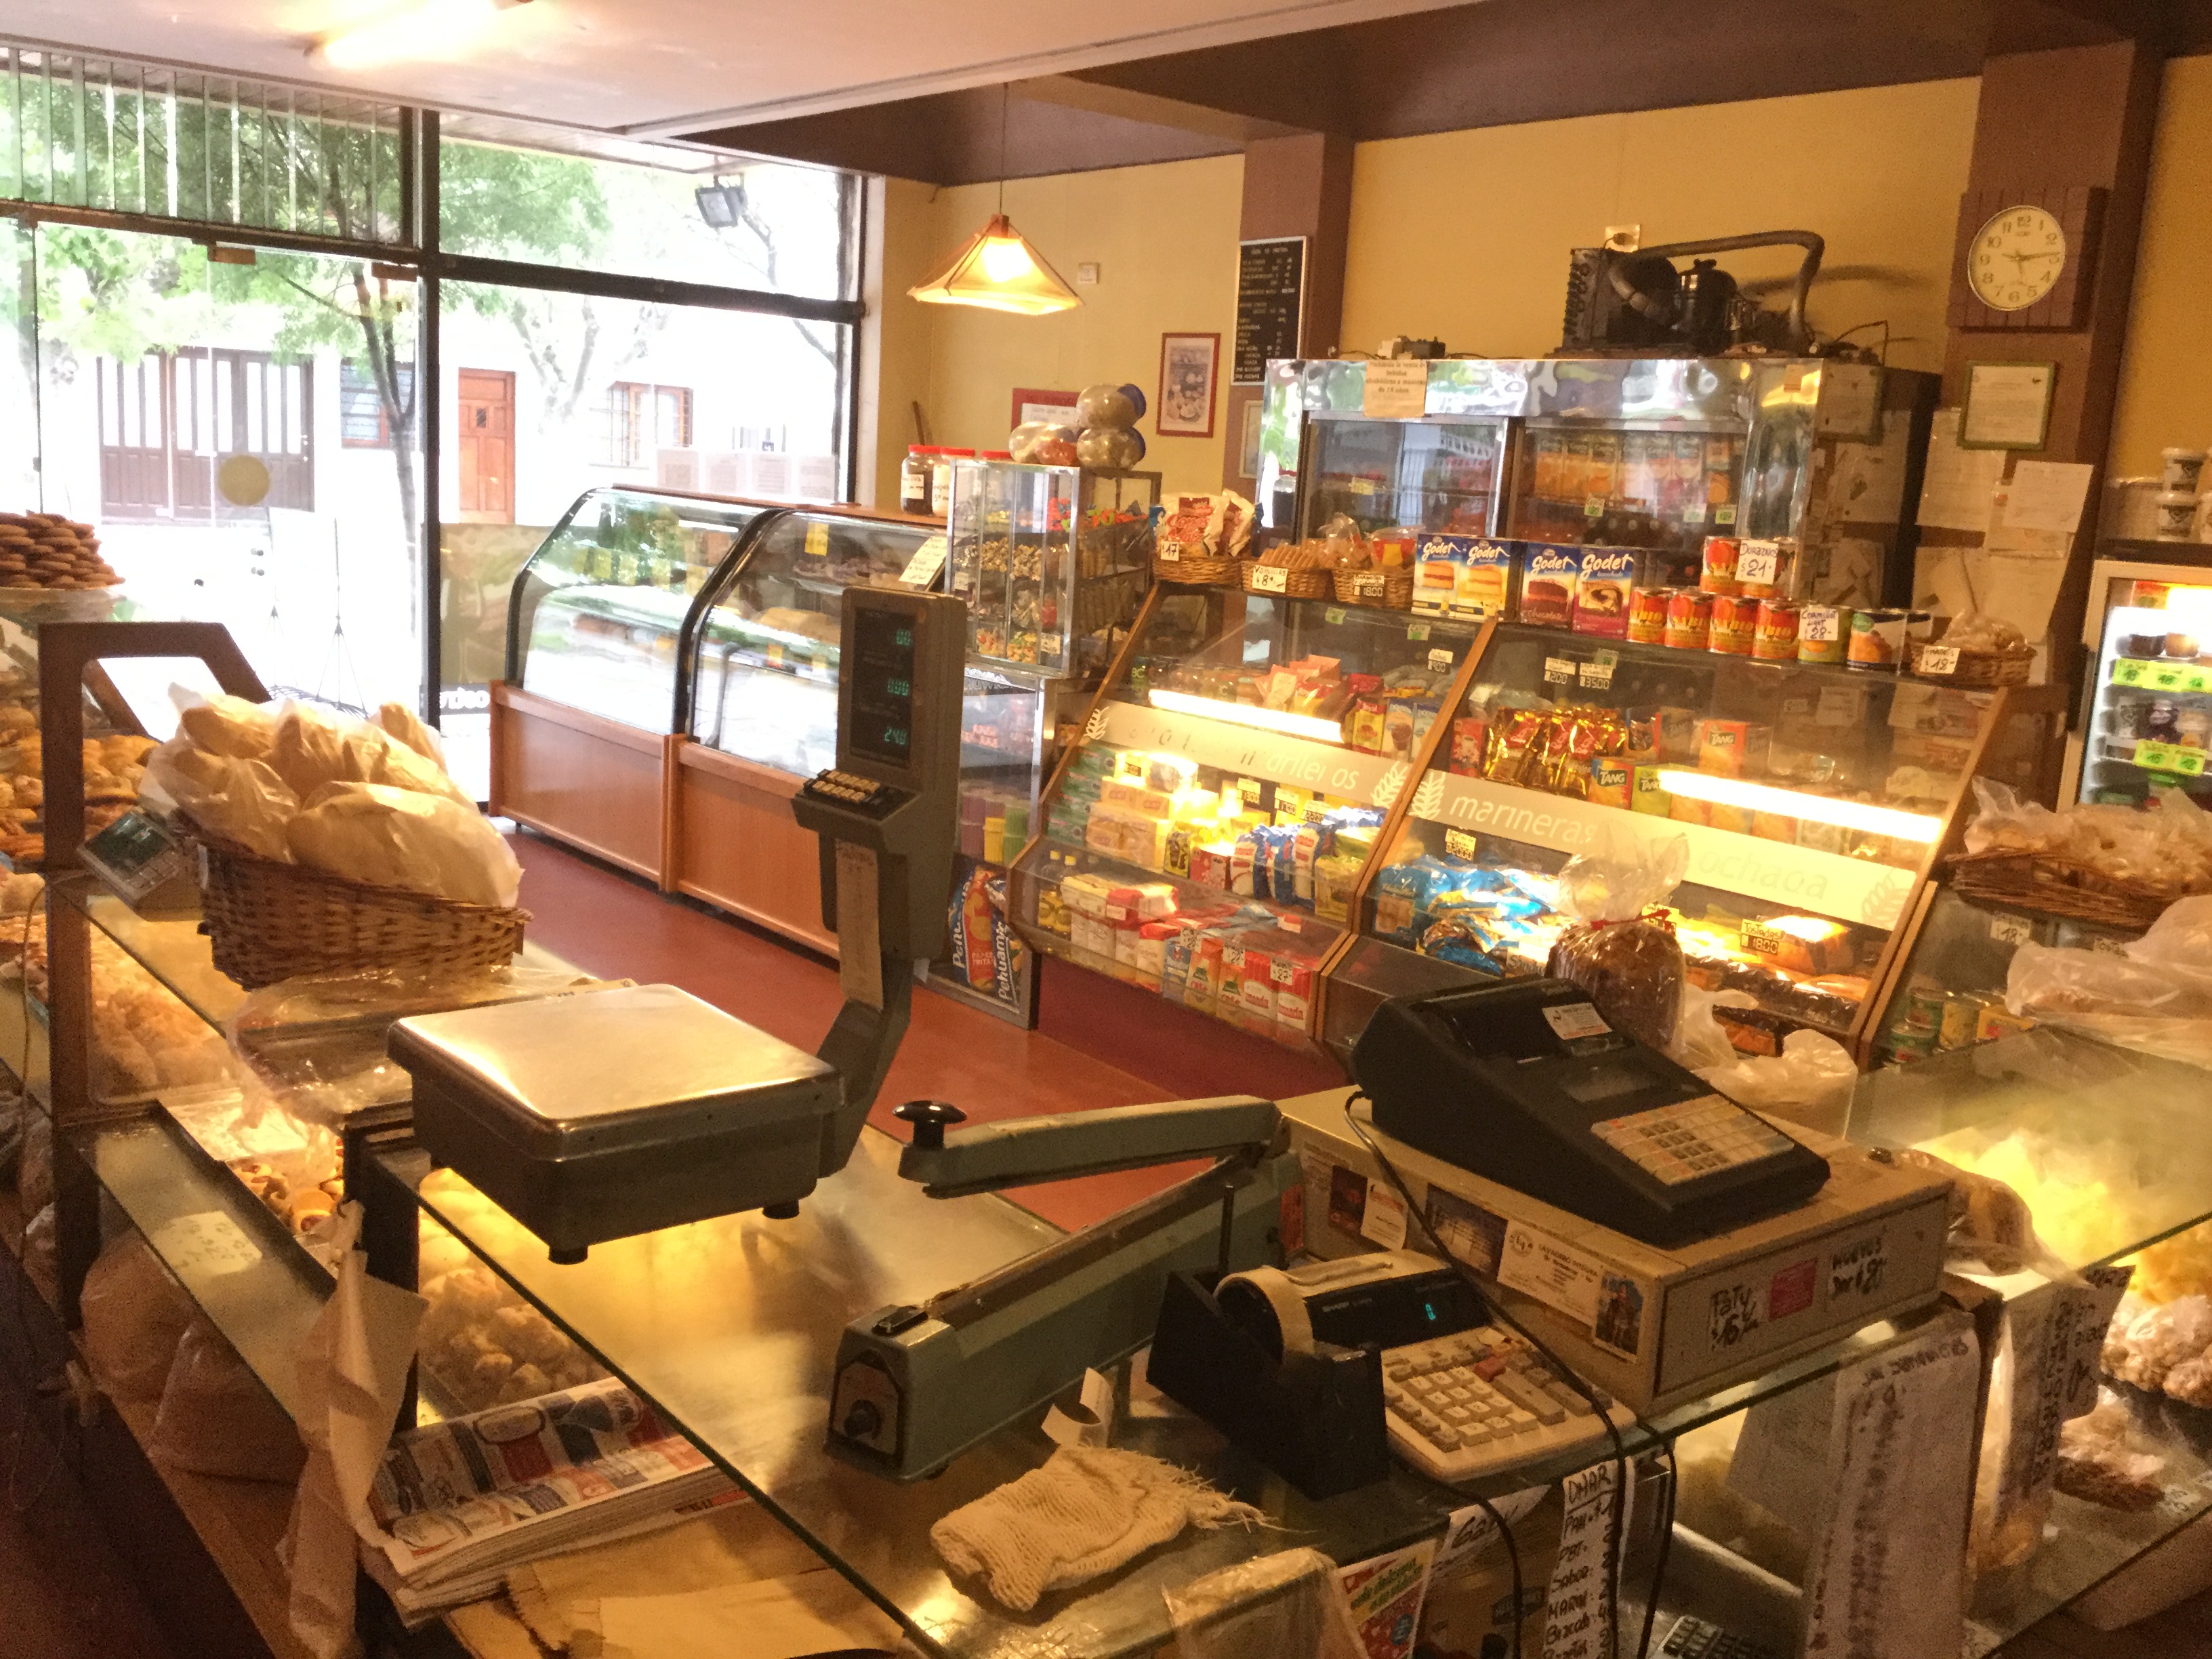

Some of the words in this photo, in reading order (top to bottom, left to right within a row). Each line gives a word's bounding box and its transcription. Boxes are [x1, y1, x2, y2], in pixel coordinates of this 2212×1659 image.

[1987, 235, 2002, 249] 10
[2045, 232, 2057, 245] 2
[1980, 253, 1991, 266] 9
[1982, 272, 1994, 285] 8
[2008, 291, 2020, 304] 6
[2026, 285, 2037, 298] 5
[1421, 541, 1461, 562] Godet
[1467, 546, 1511, 566] Godet
[1530, 555, 1578, 576] Godet
[1580, 553, 1635, 582] Godet
[1712, 732, 1735, 746] TANG
[1599, 769, 1626, 784] TANG
[1449, 796, 1598, 844] marineras
